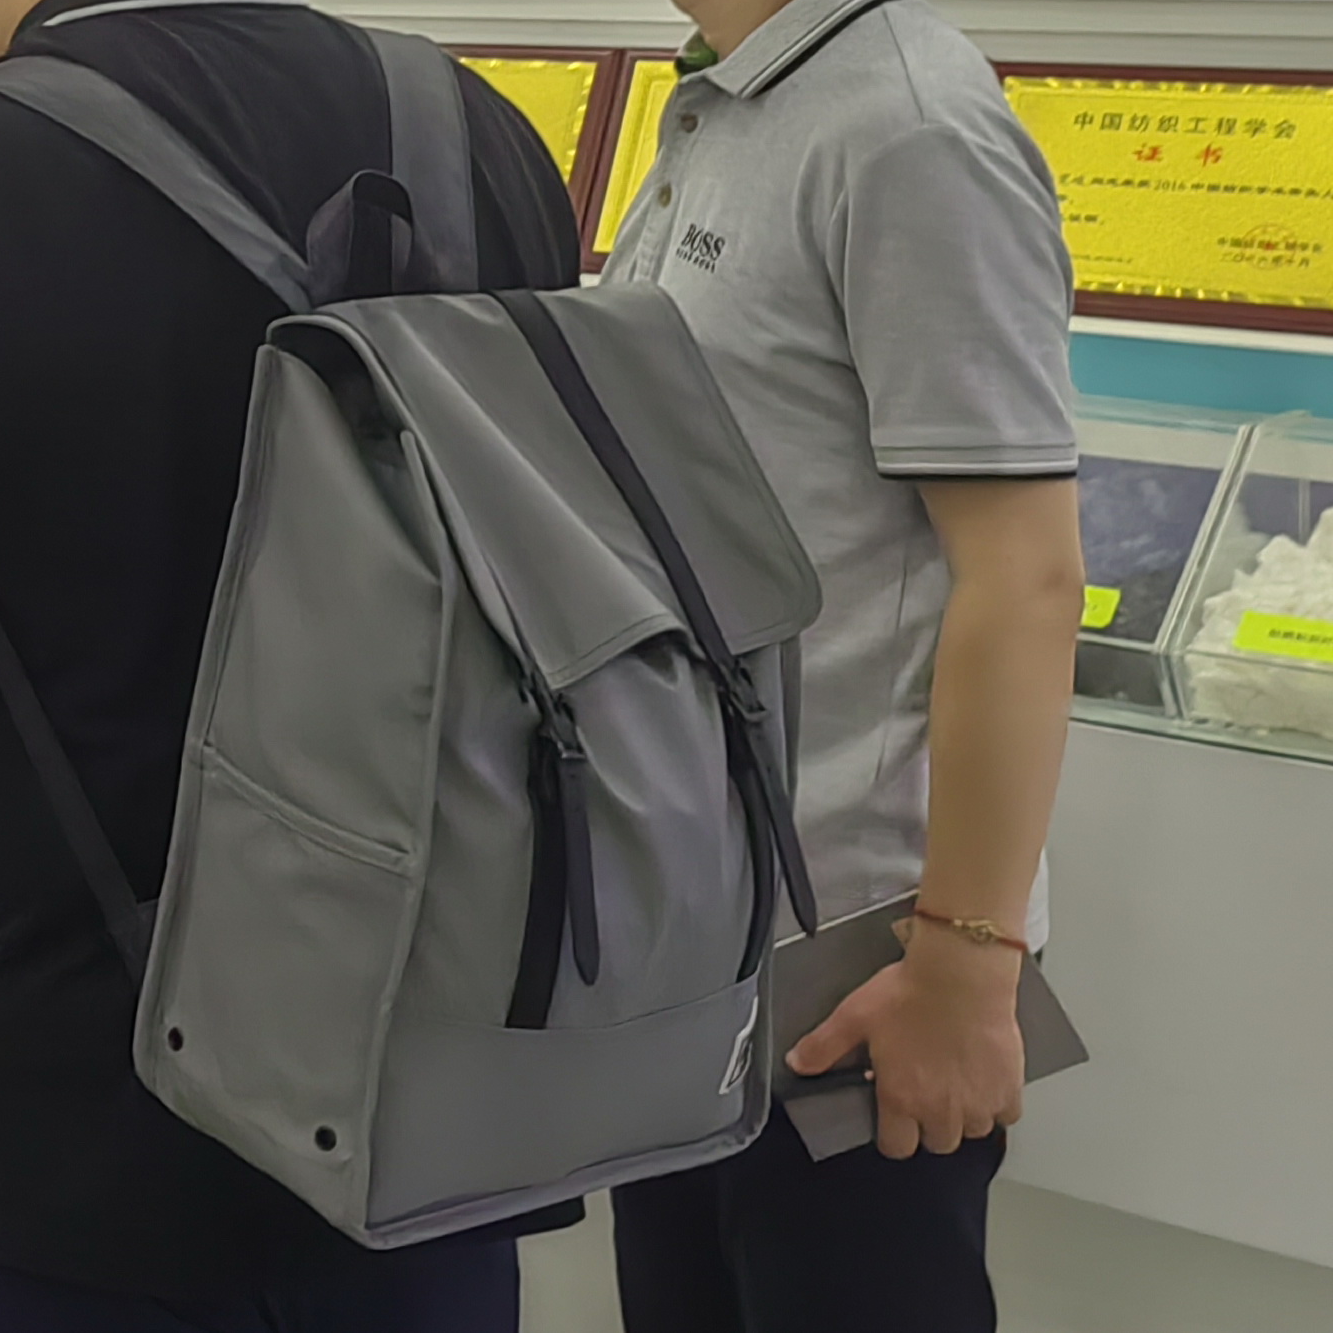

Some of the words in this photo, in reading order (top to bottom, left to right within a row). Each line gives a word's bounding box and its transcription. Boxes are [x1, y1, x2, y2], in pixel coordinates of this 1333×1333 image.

[1073, 111, 1297, 140] 中国纺织工程学会
[681, 223, 726, 261] BOSS
